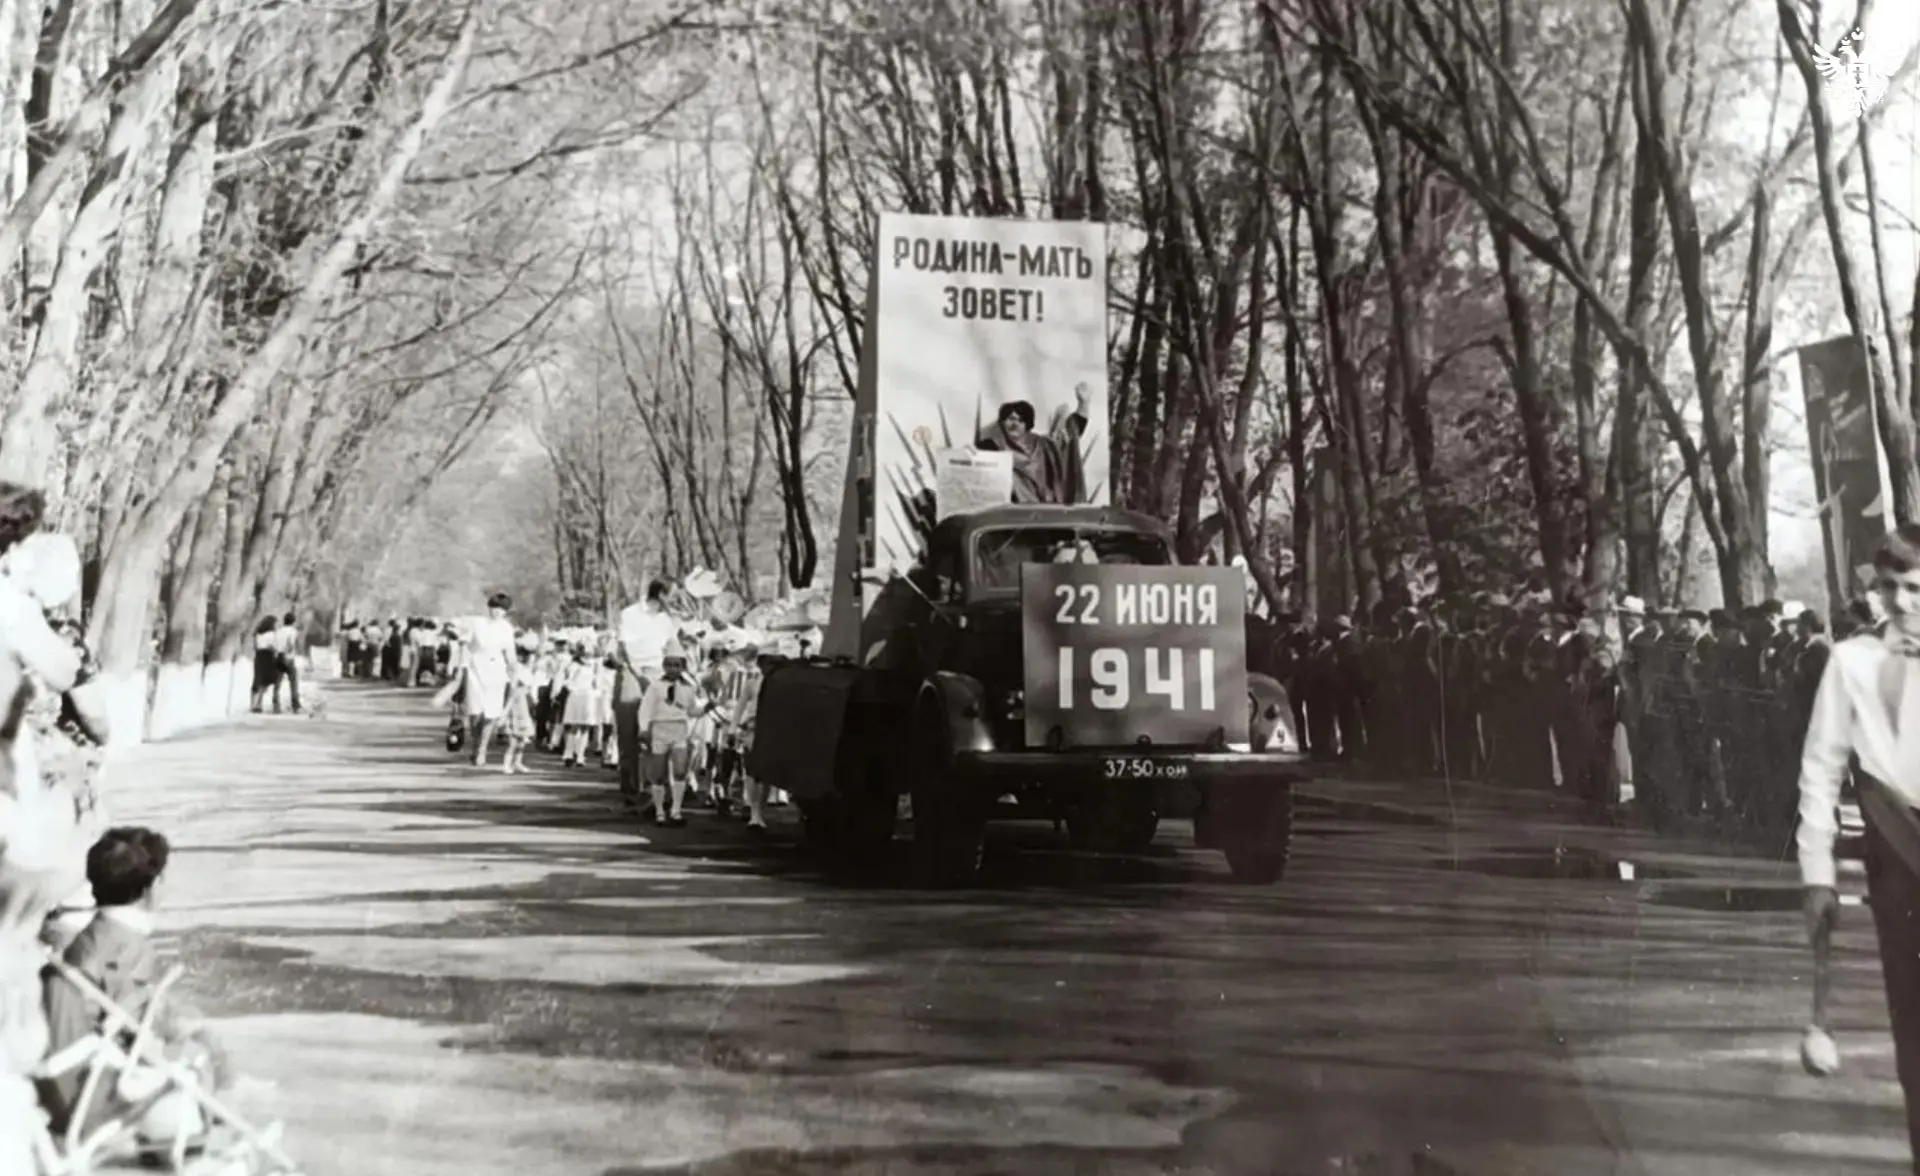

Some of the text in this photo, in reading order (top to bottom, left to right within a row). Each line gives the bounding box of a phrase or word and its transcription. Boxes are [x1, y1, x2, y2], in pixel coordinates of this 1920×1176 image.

[893, 235, 1093, 279] РОДИНА-МАТЬ
[942, 285, 1044, 322] ЗОВЕТ!
[1055, 583, 1217, 625] 22 ИЮНЯ
[1058, 646, 1216, 710] 1941
